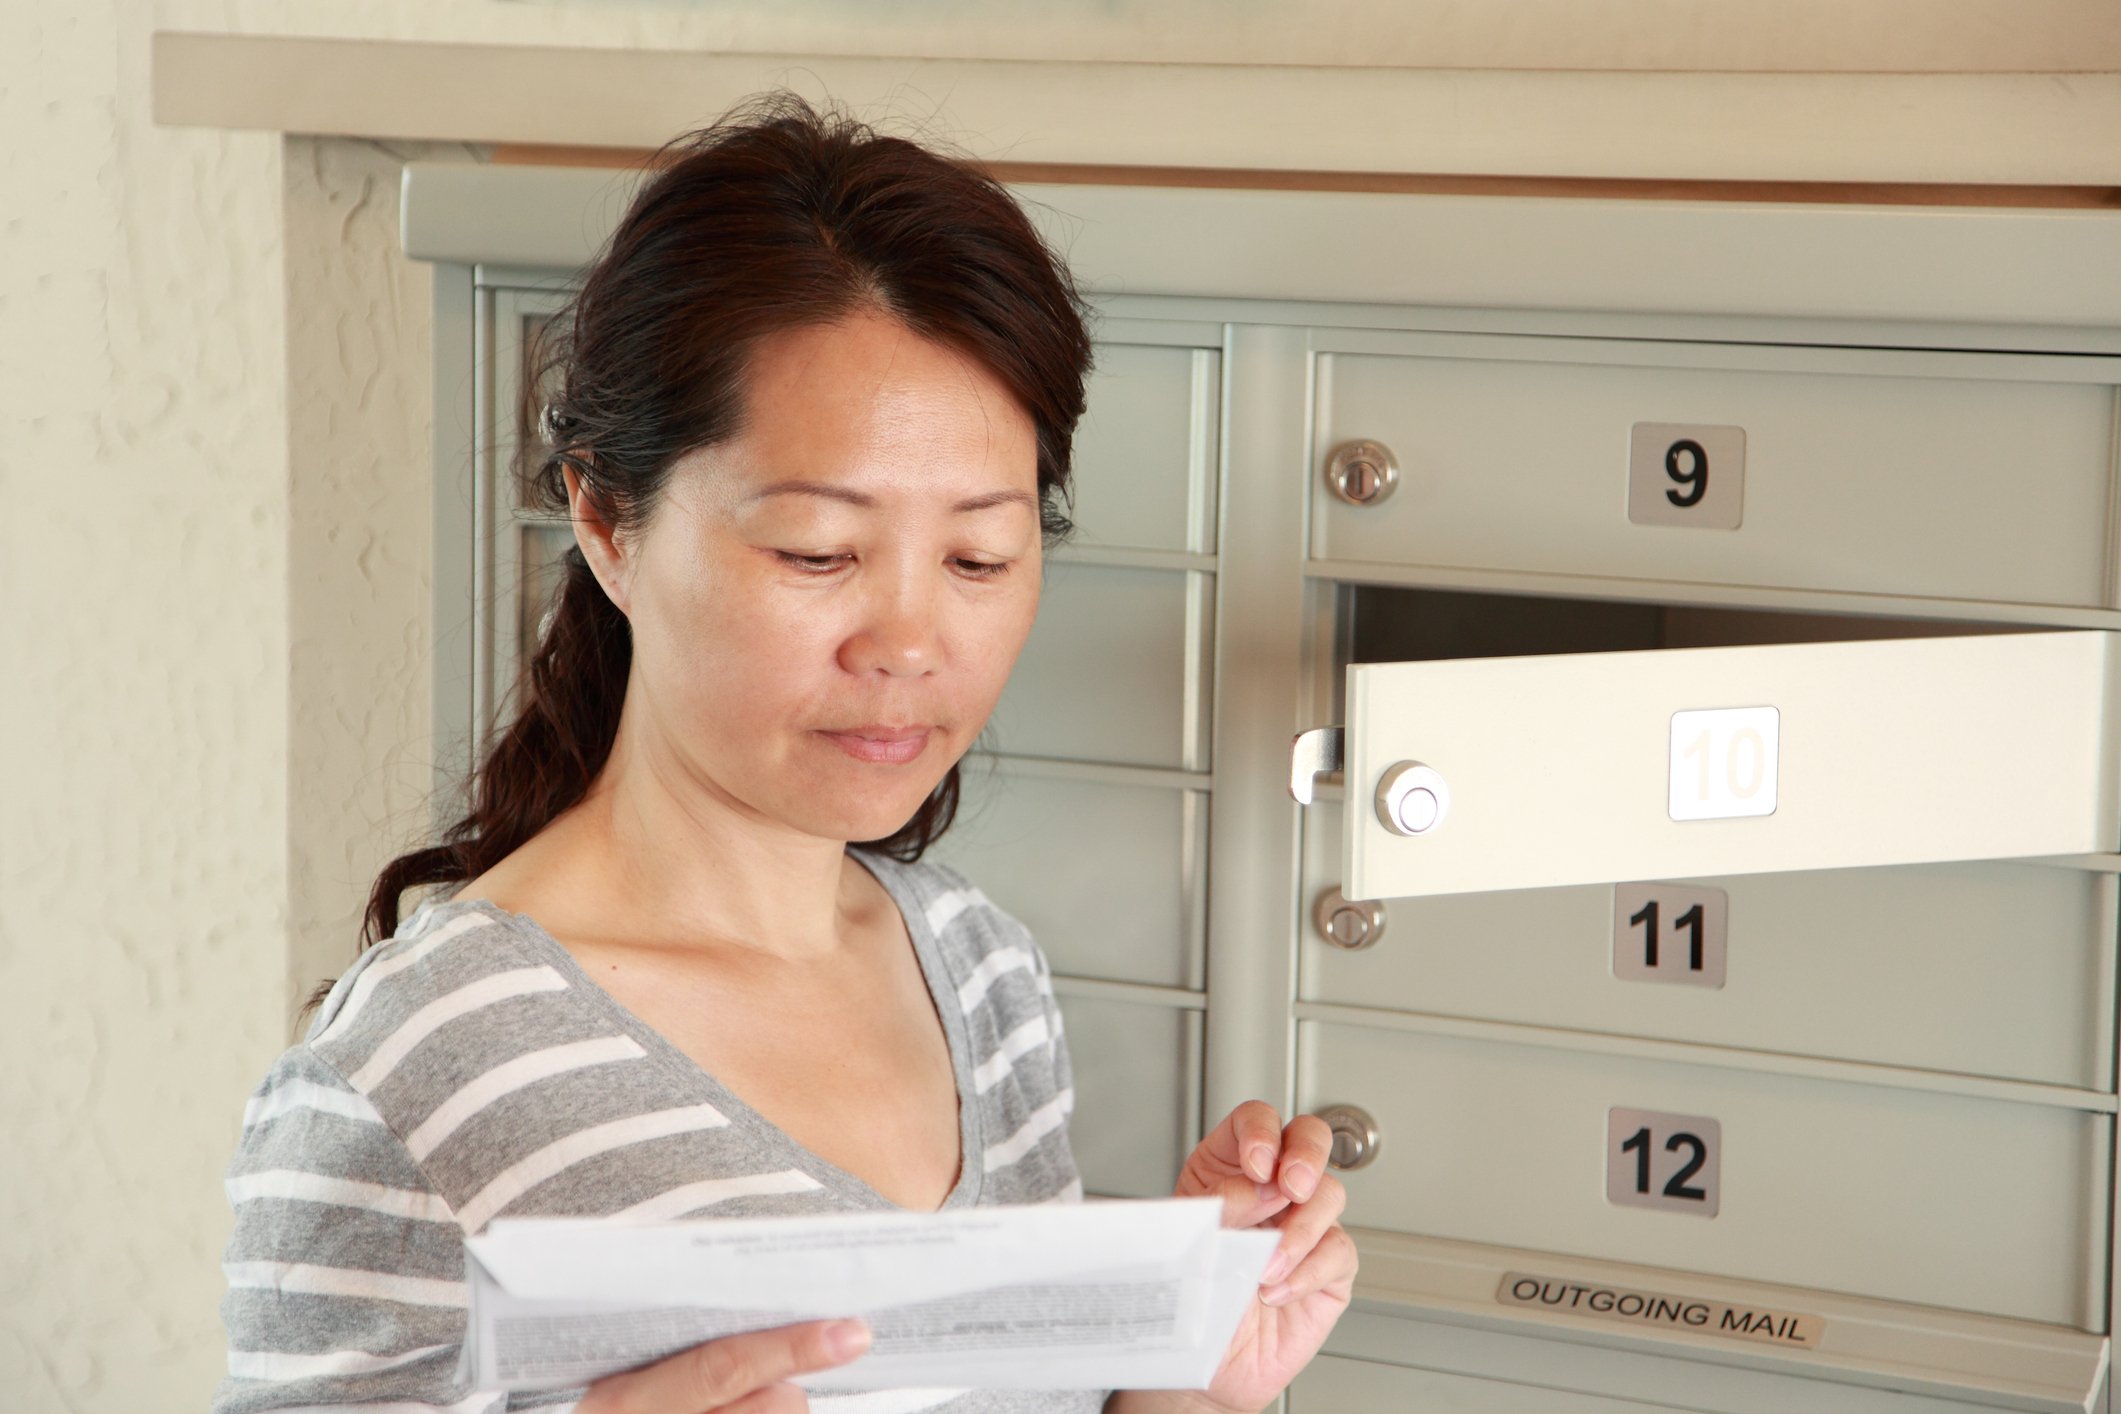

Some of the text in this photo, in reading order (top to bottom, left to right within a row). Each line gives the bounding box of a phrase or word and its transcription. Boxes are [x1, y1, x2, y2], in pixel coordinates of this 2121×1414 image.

[1666, 440, 1708, 507] 9
[1683, 727, 1765, 801] 10
[1631, 901, 1703, 971] 11
[1623, 1128, 1706, 1201] 12
[1512, 1279, 1805, 1341] OUTGOING MAIL
